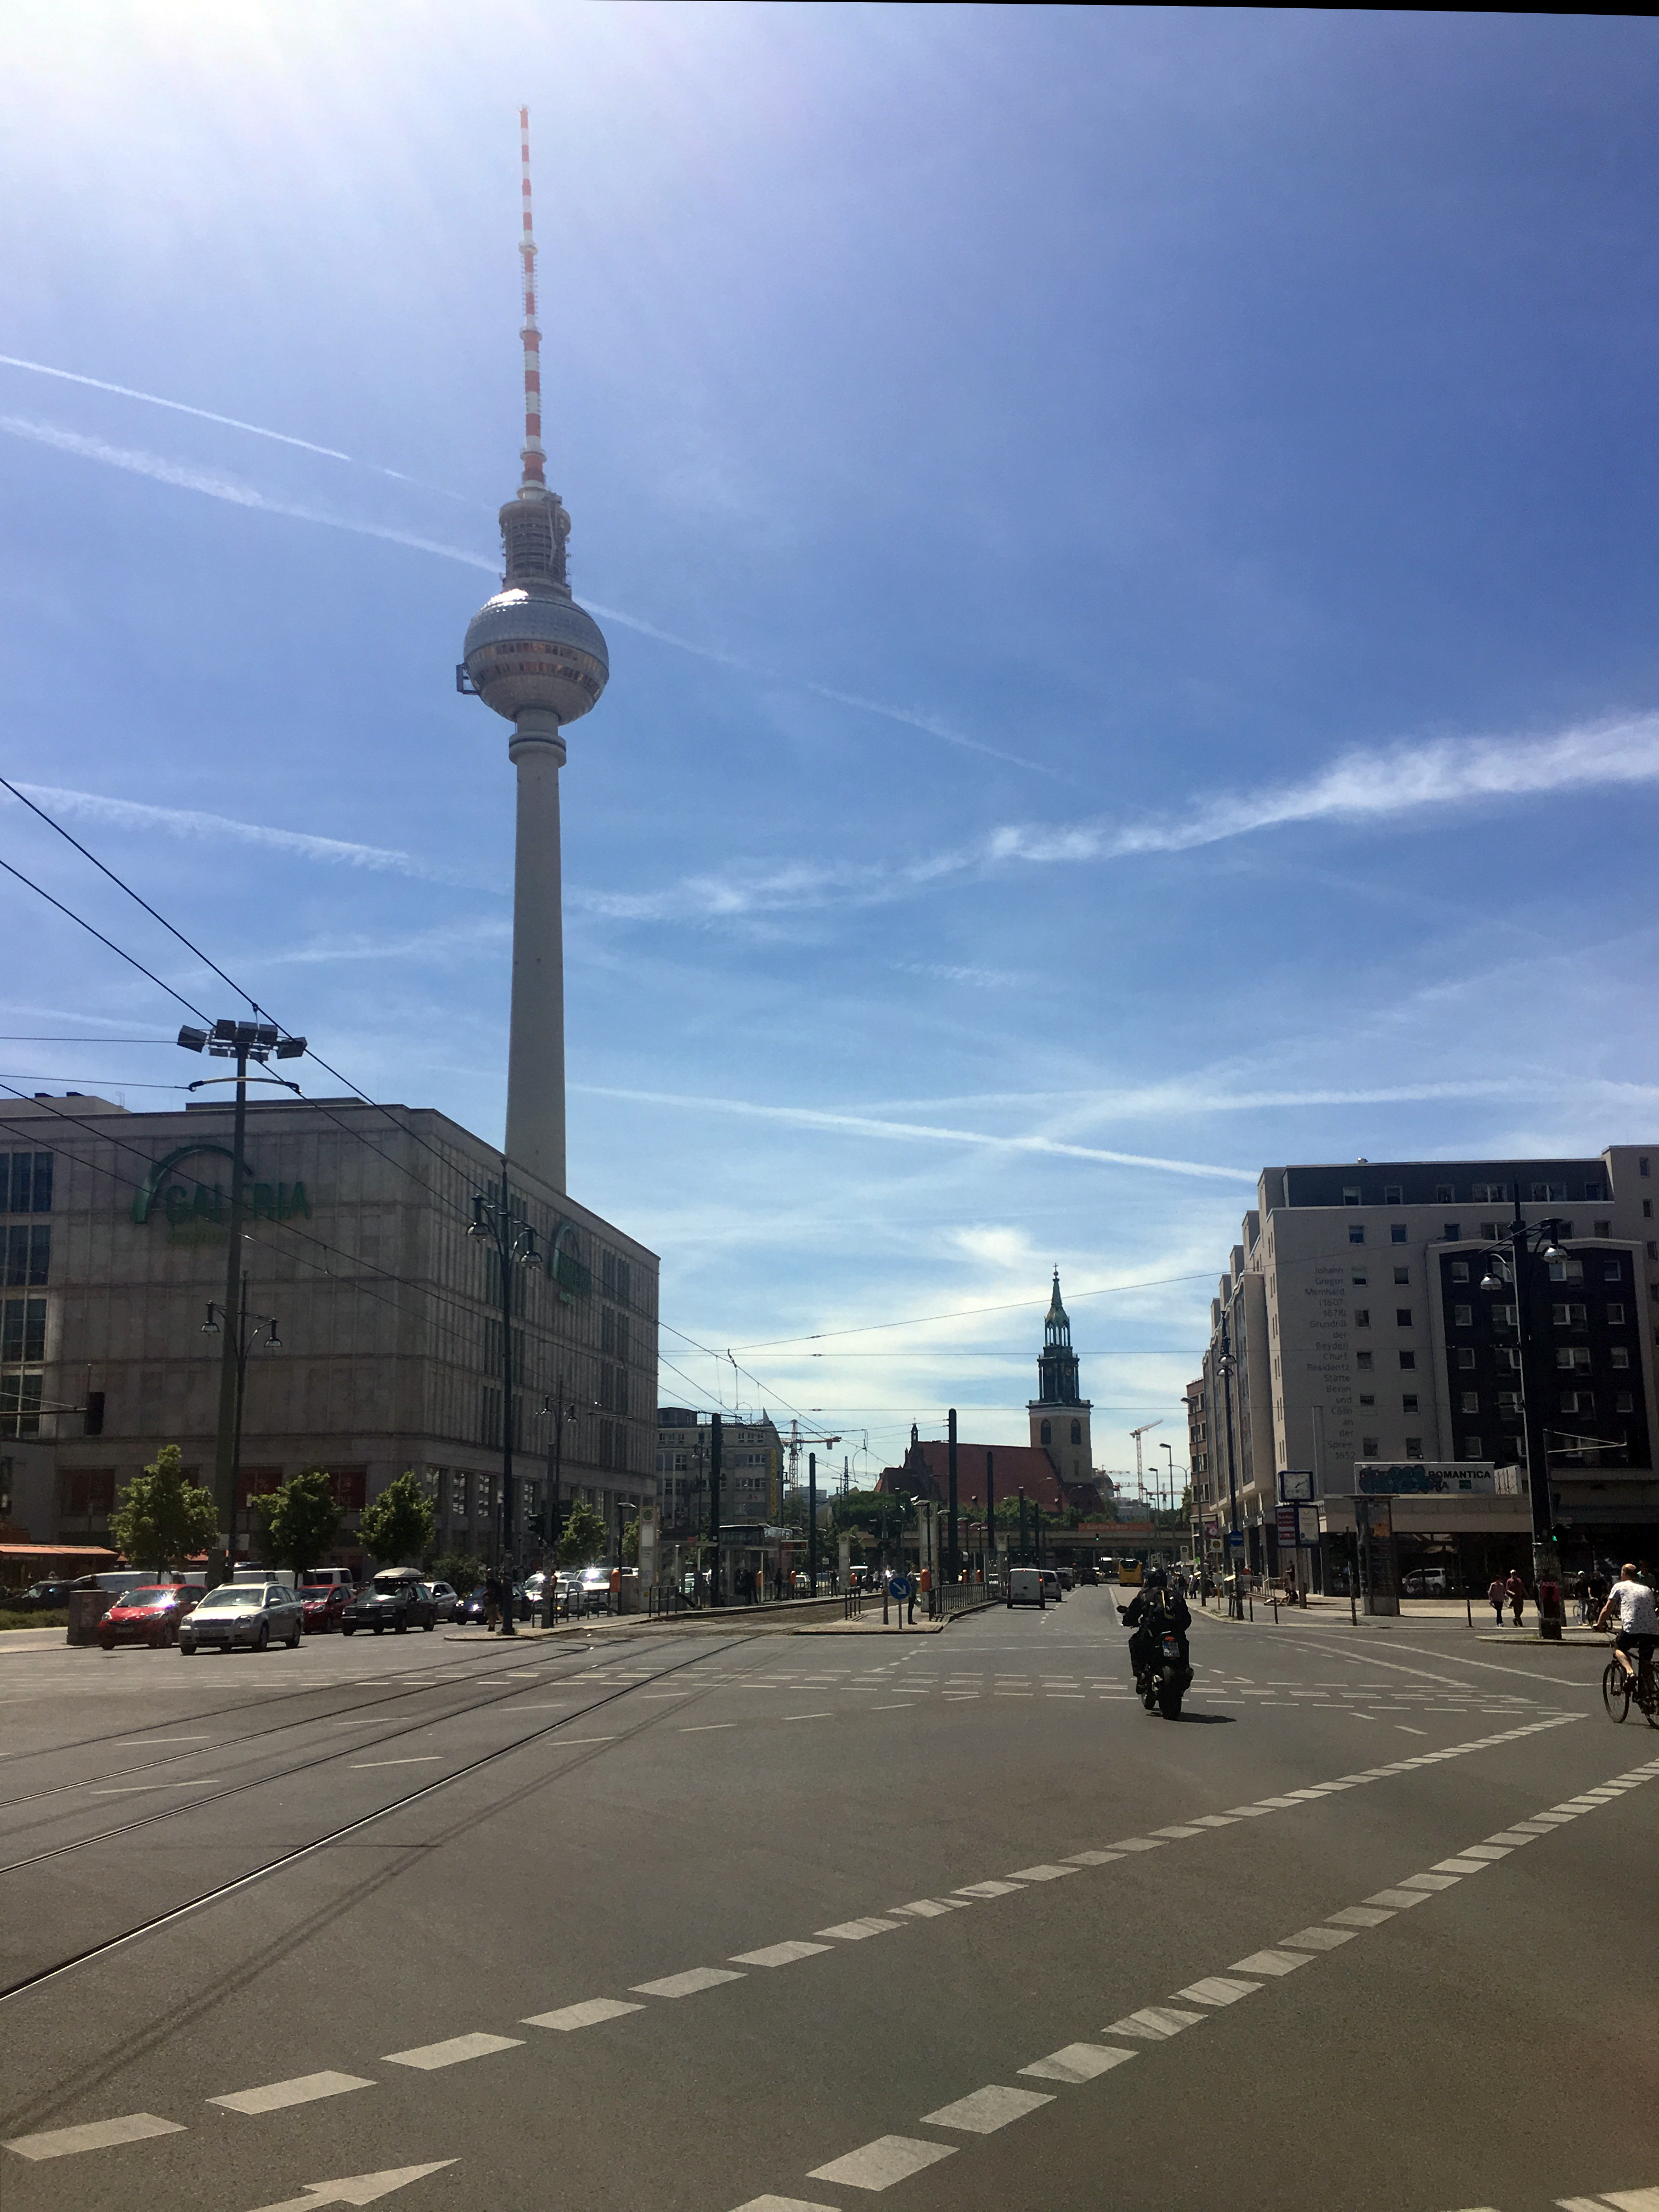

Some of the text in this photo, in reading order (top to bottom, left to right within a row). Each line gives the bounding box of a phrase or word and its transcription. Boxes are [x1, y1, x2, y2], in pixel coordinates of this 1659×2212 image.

[1315, 1277, 1344, 1286] Gregor
[1316, 1342, 1348, 1351] Beyden
[1307, 1363, 1350, 1372] Residentz
[1336, 1396, 1352, 1404] und
[1335, 1451, 1356, 1460] 1652
